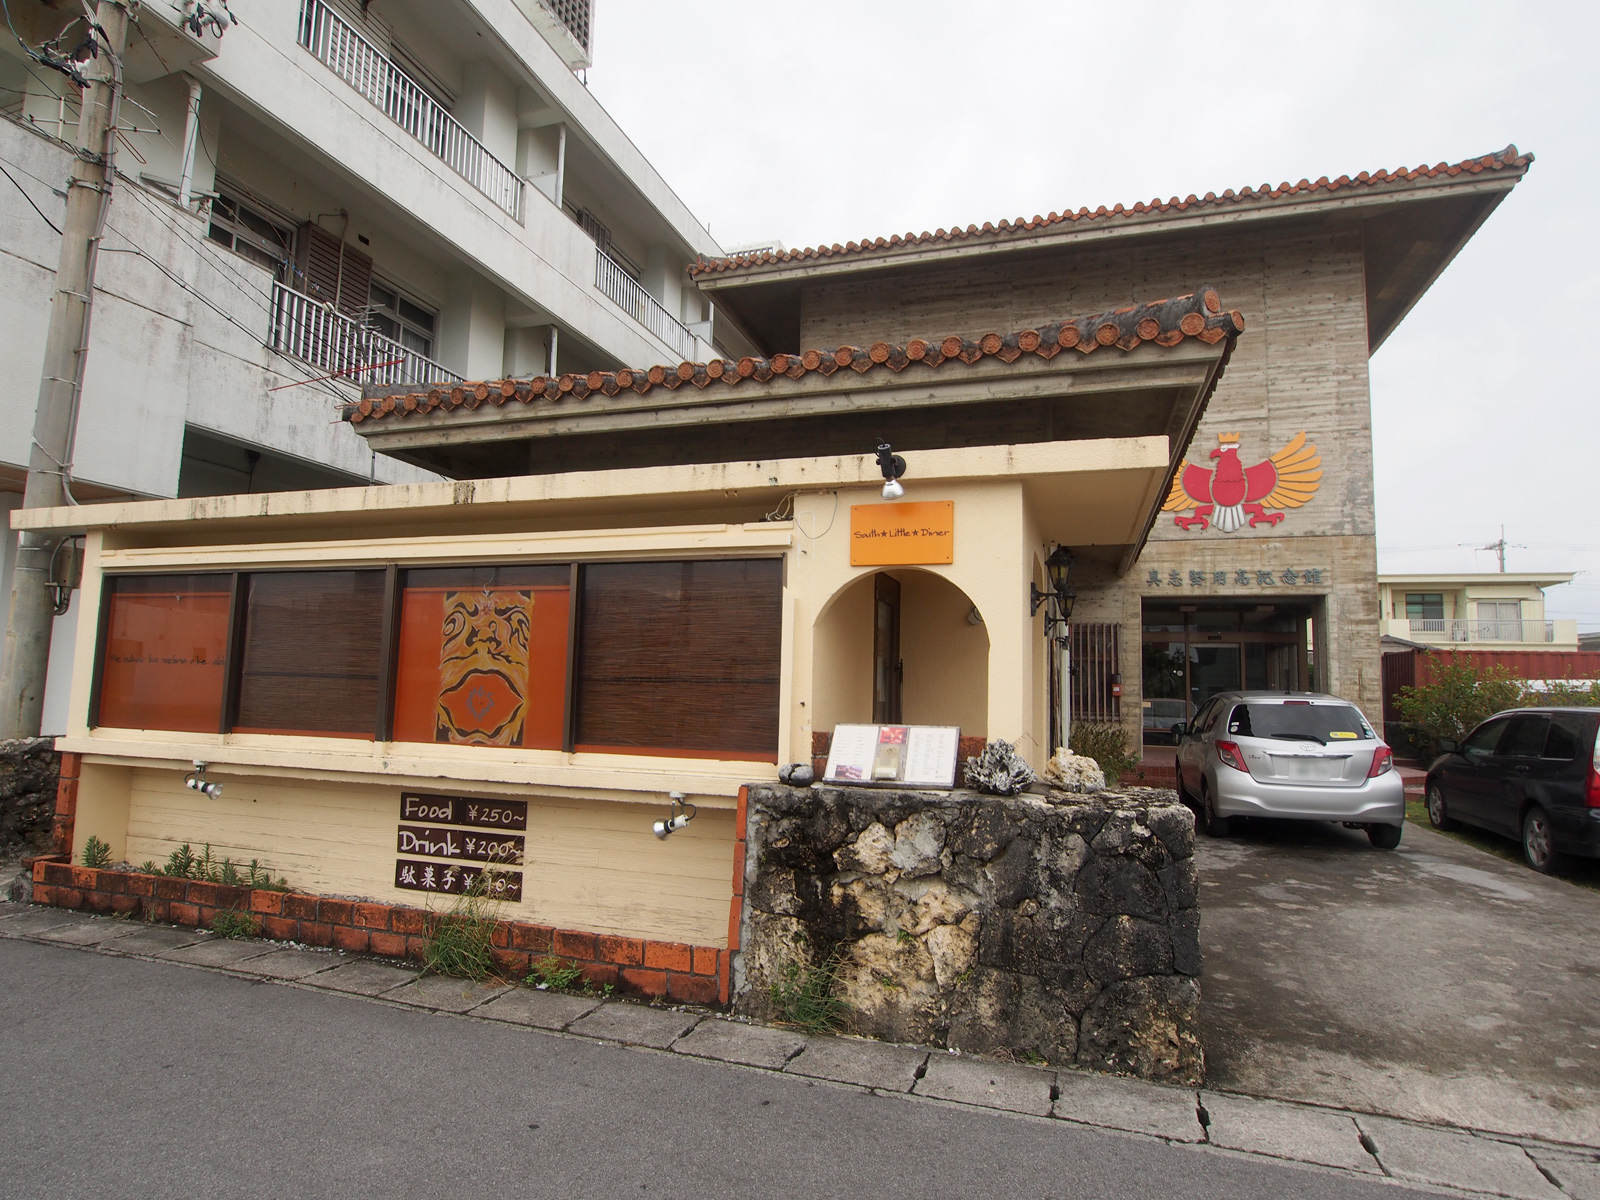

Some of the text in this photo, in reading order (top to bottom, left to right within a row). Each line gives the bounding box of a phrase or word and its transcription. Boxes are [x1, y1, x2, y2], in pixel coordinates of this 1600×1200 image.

[854, 528, 949, 539] South Little Diner
[405, 797, 452, 820] Food
[399, 830, 461, 856] Drink
[399, 865, 456, 890] 駄菓子
